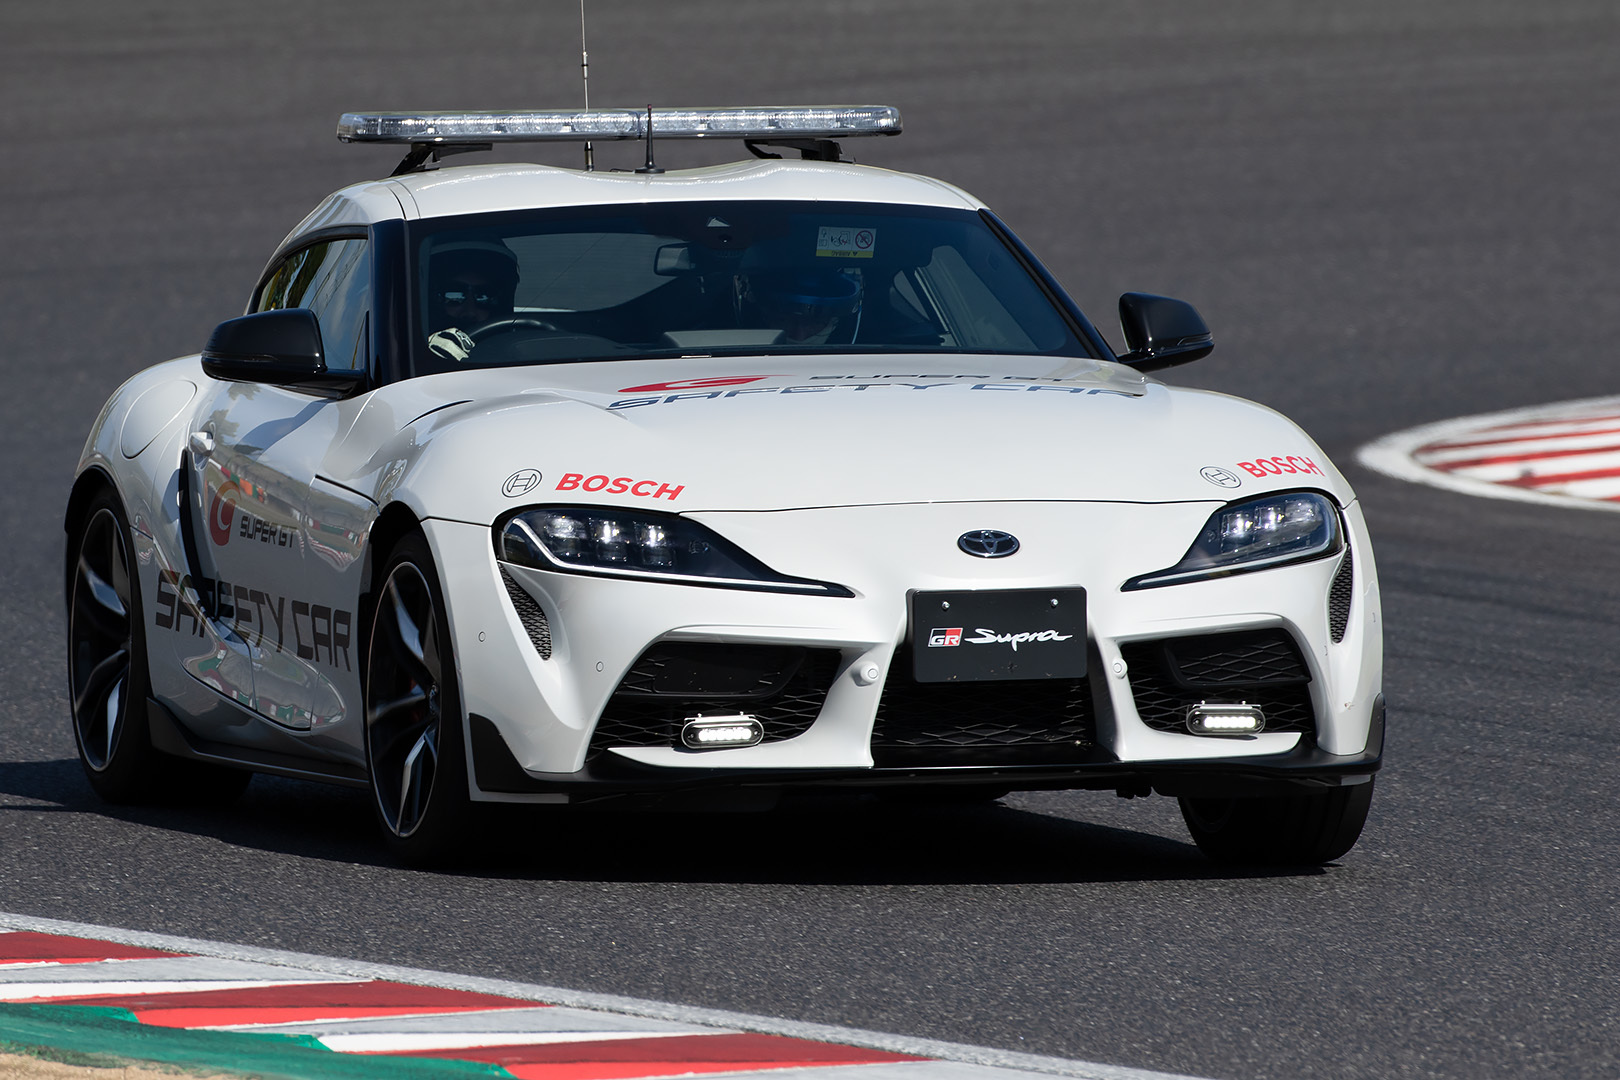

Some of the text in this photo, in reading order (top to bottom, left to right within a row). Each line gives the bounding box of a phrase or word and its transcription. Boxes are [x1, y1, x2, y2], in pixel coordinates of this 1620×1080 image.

[606, 383, 1144, 410] SAFETY CAR
[1236, 456, 1326, 478] BOSCH
[555, 473, 686, 500] BOSCH
[239, 515, 295, 548] SUPER GT
[291, 600, 352, 672] CAR
[929, 628, 1073, 651] GR Supra
